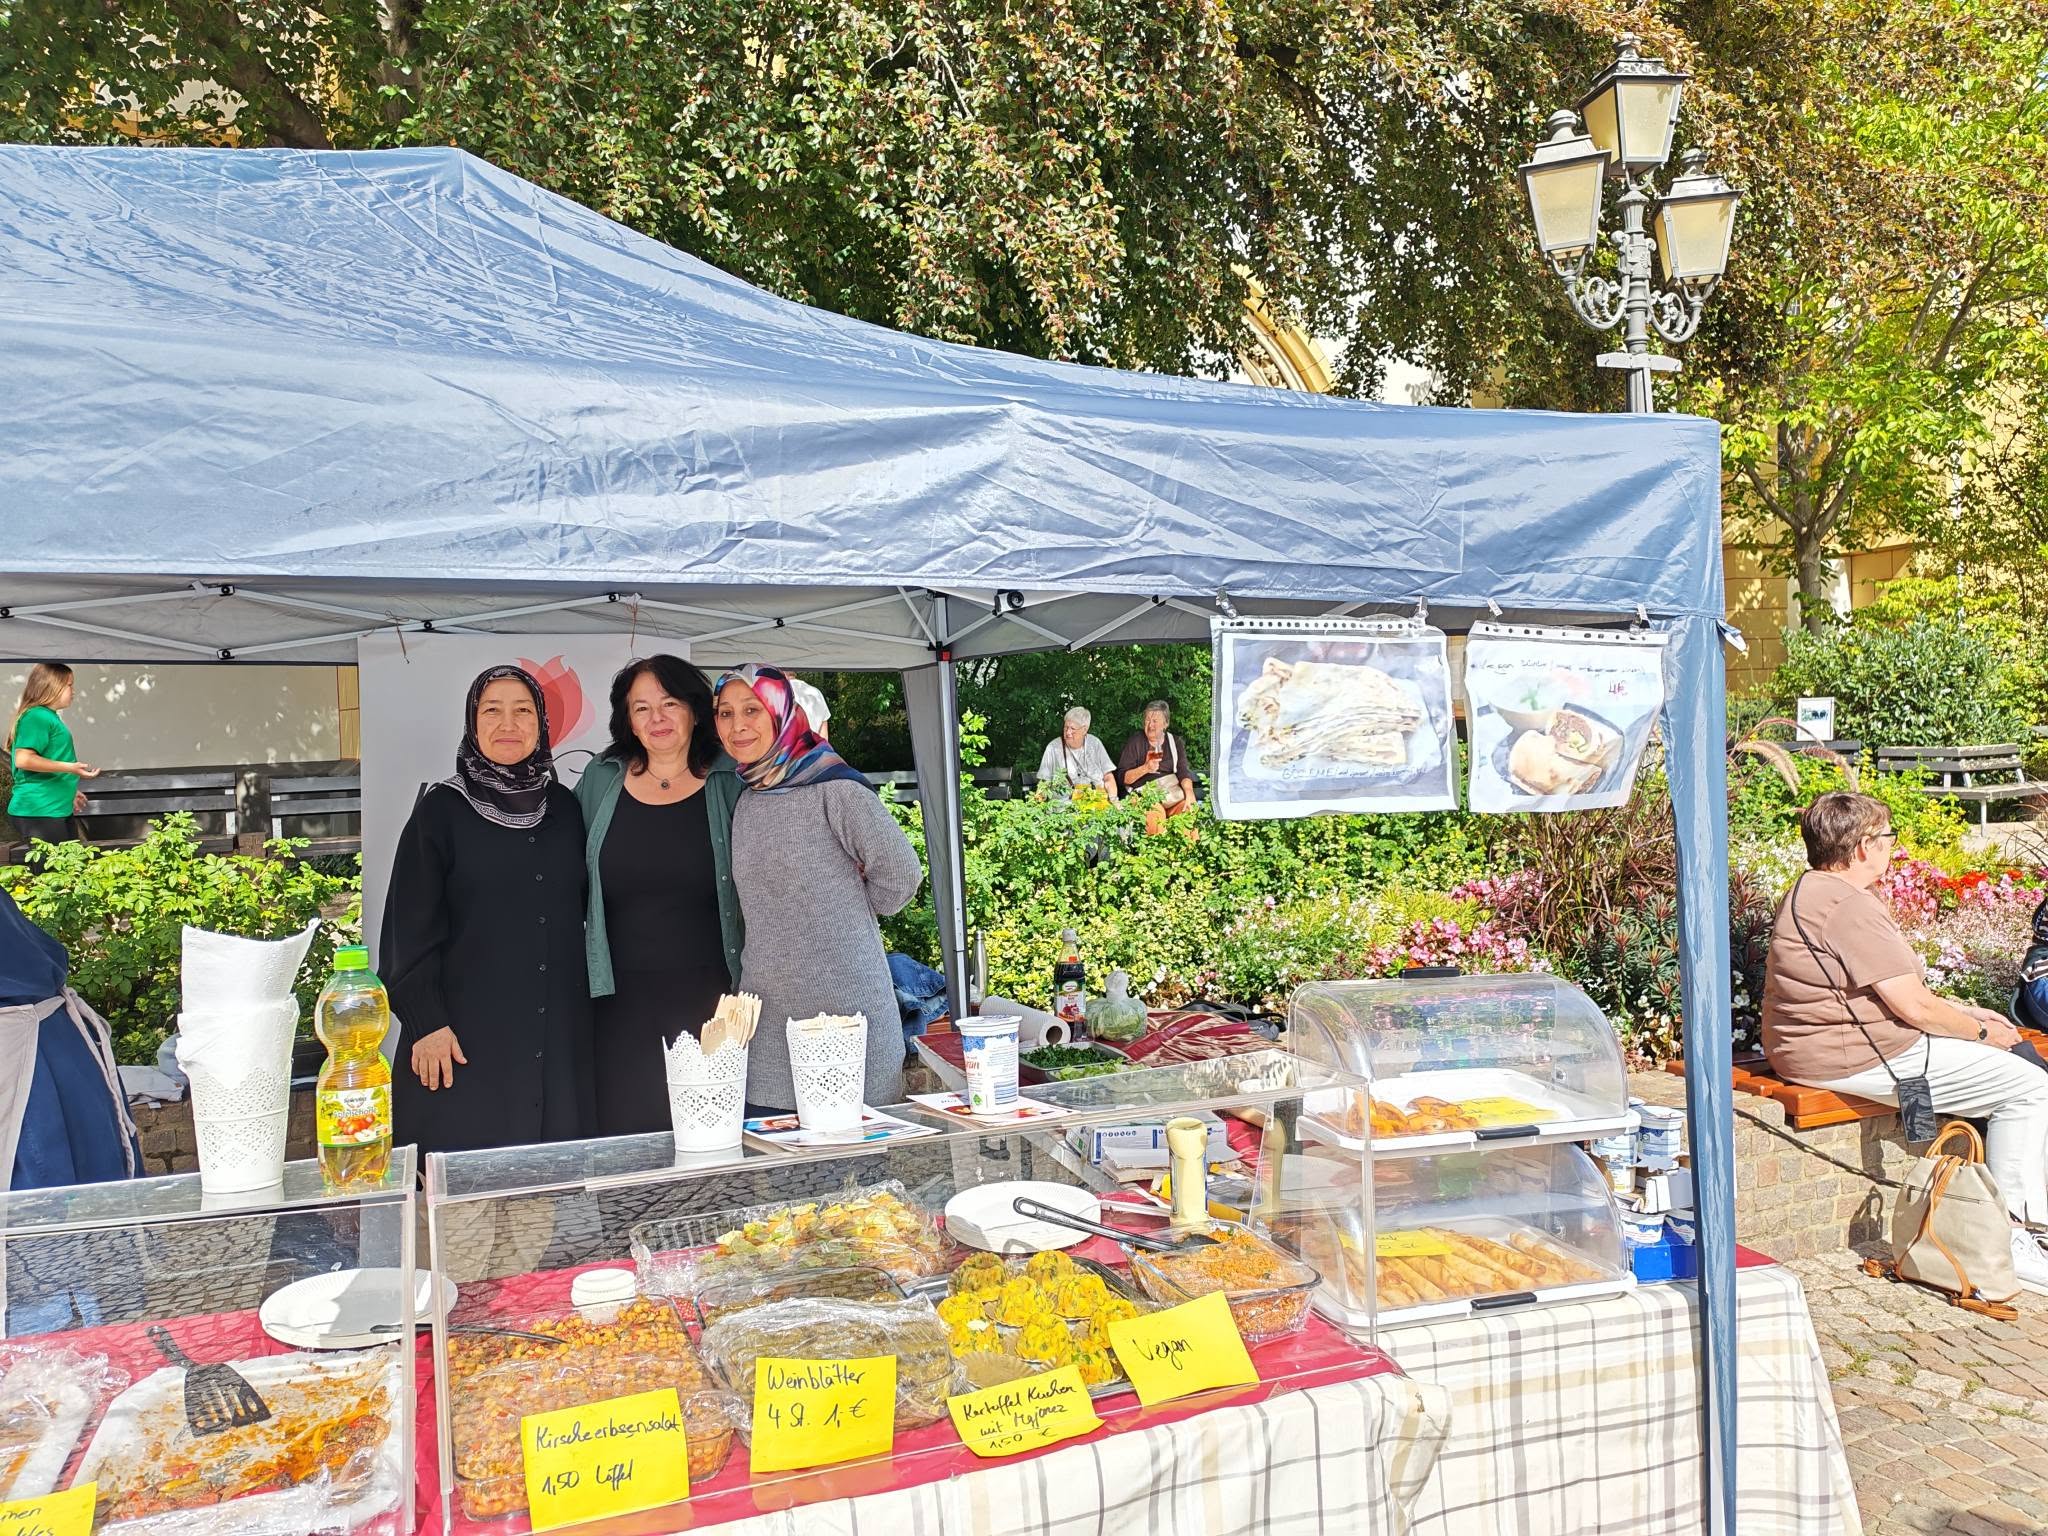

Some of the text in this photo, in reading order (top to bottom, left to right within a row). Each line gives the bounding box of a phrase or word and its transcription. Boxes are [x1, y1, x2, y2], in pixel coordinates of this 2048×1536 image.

[1132, 1337, 1193, 1371] Vegan
[767, 1363, 866, 1390] Weinblätter
[1027, 1379, 1077, 1402] Kuchen
[768, 1403, 781, 1429] 4
[980, 1420, 1003, 1437] mit
[990, 1433, 1023, 1449] 1,50
[542, 1471, 580, 1496] 1,50
